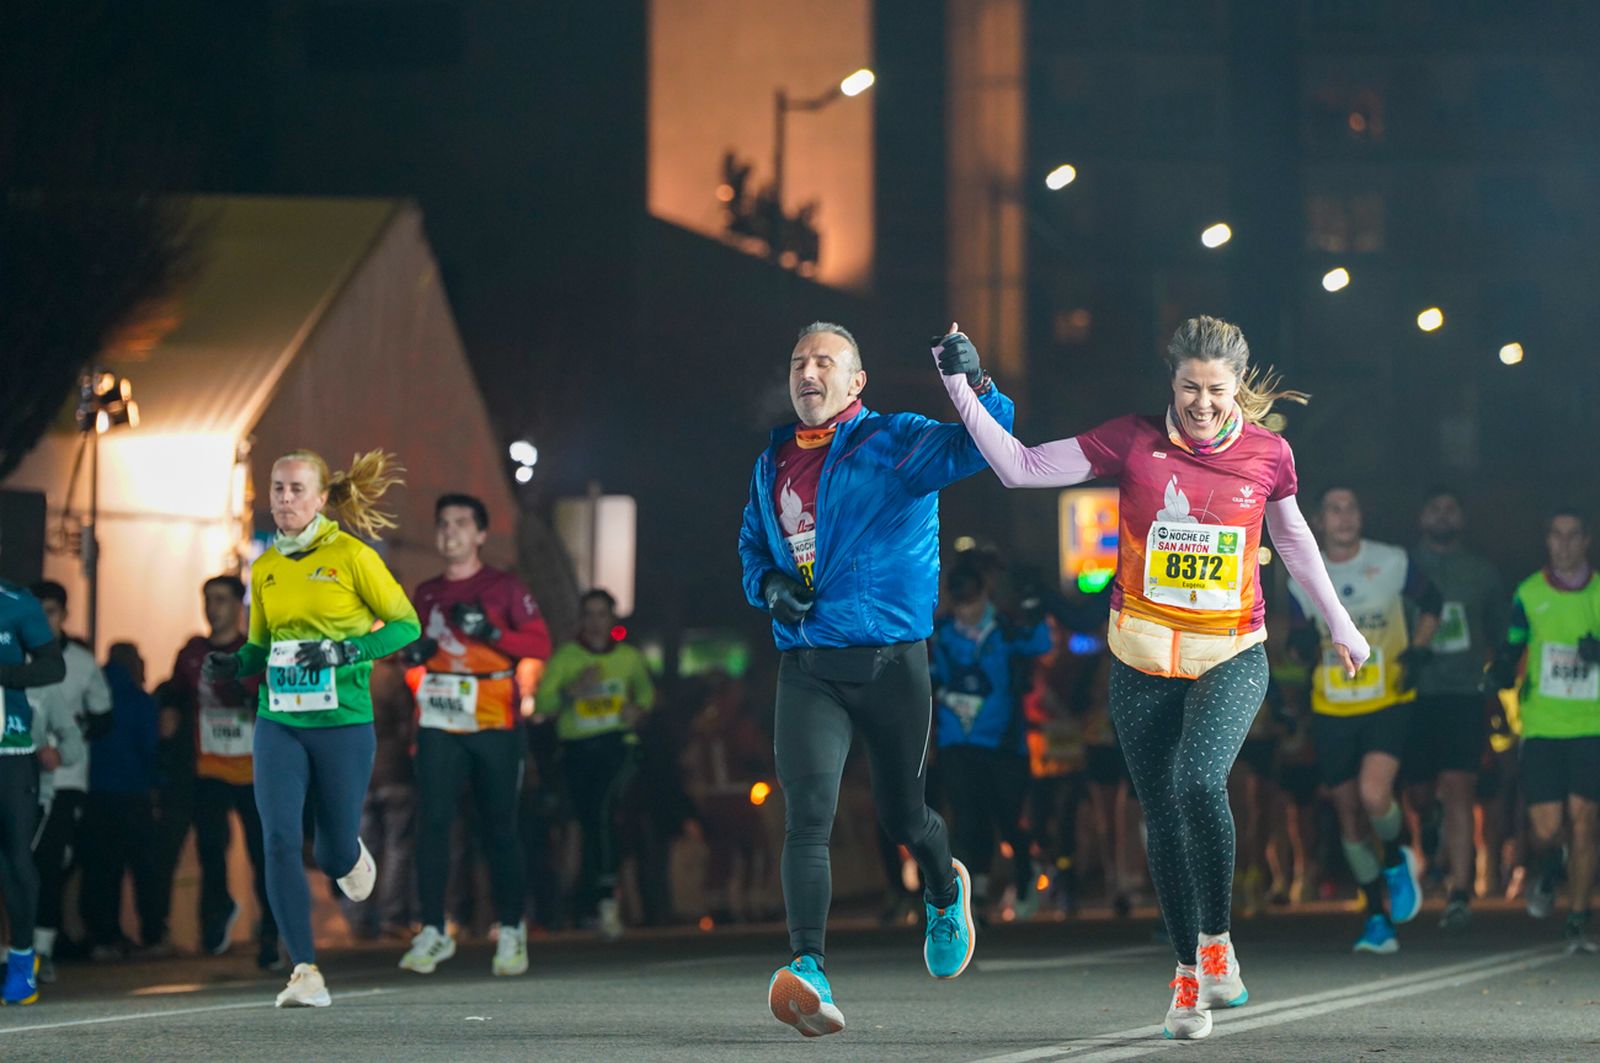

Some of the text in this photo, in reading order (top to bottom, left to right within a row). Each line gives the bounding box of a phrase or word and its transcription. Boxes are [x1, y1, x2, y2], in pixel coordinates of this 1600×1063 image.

[1169, 532, 1210, 542] NOCHE DE
[795, 542, 815, 552] NOCH
[1158, 541, 1177, 551] SAN
[1178, 542, 1209, 553] ANTÓN
[1166, 553, 1223, 580] 8372
[1182, 581, 1205, 589] Eugenia
[277, 667, 320, 687] 3020
